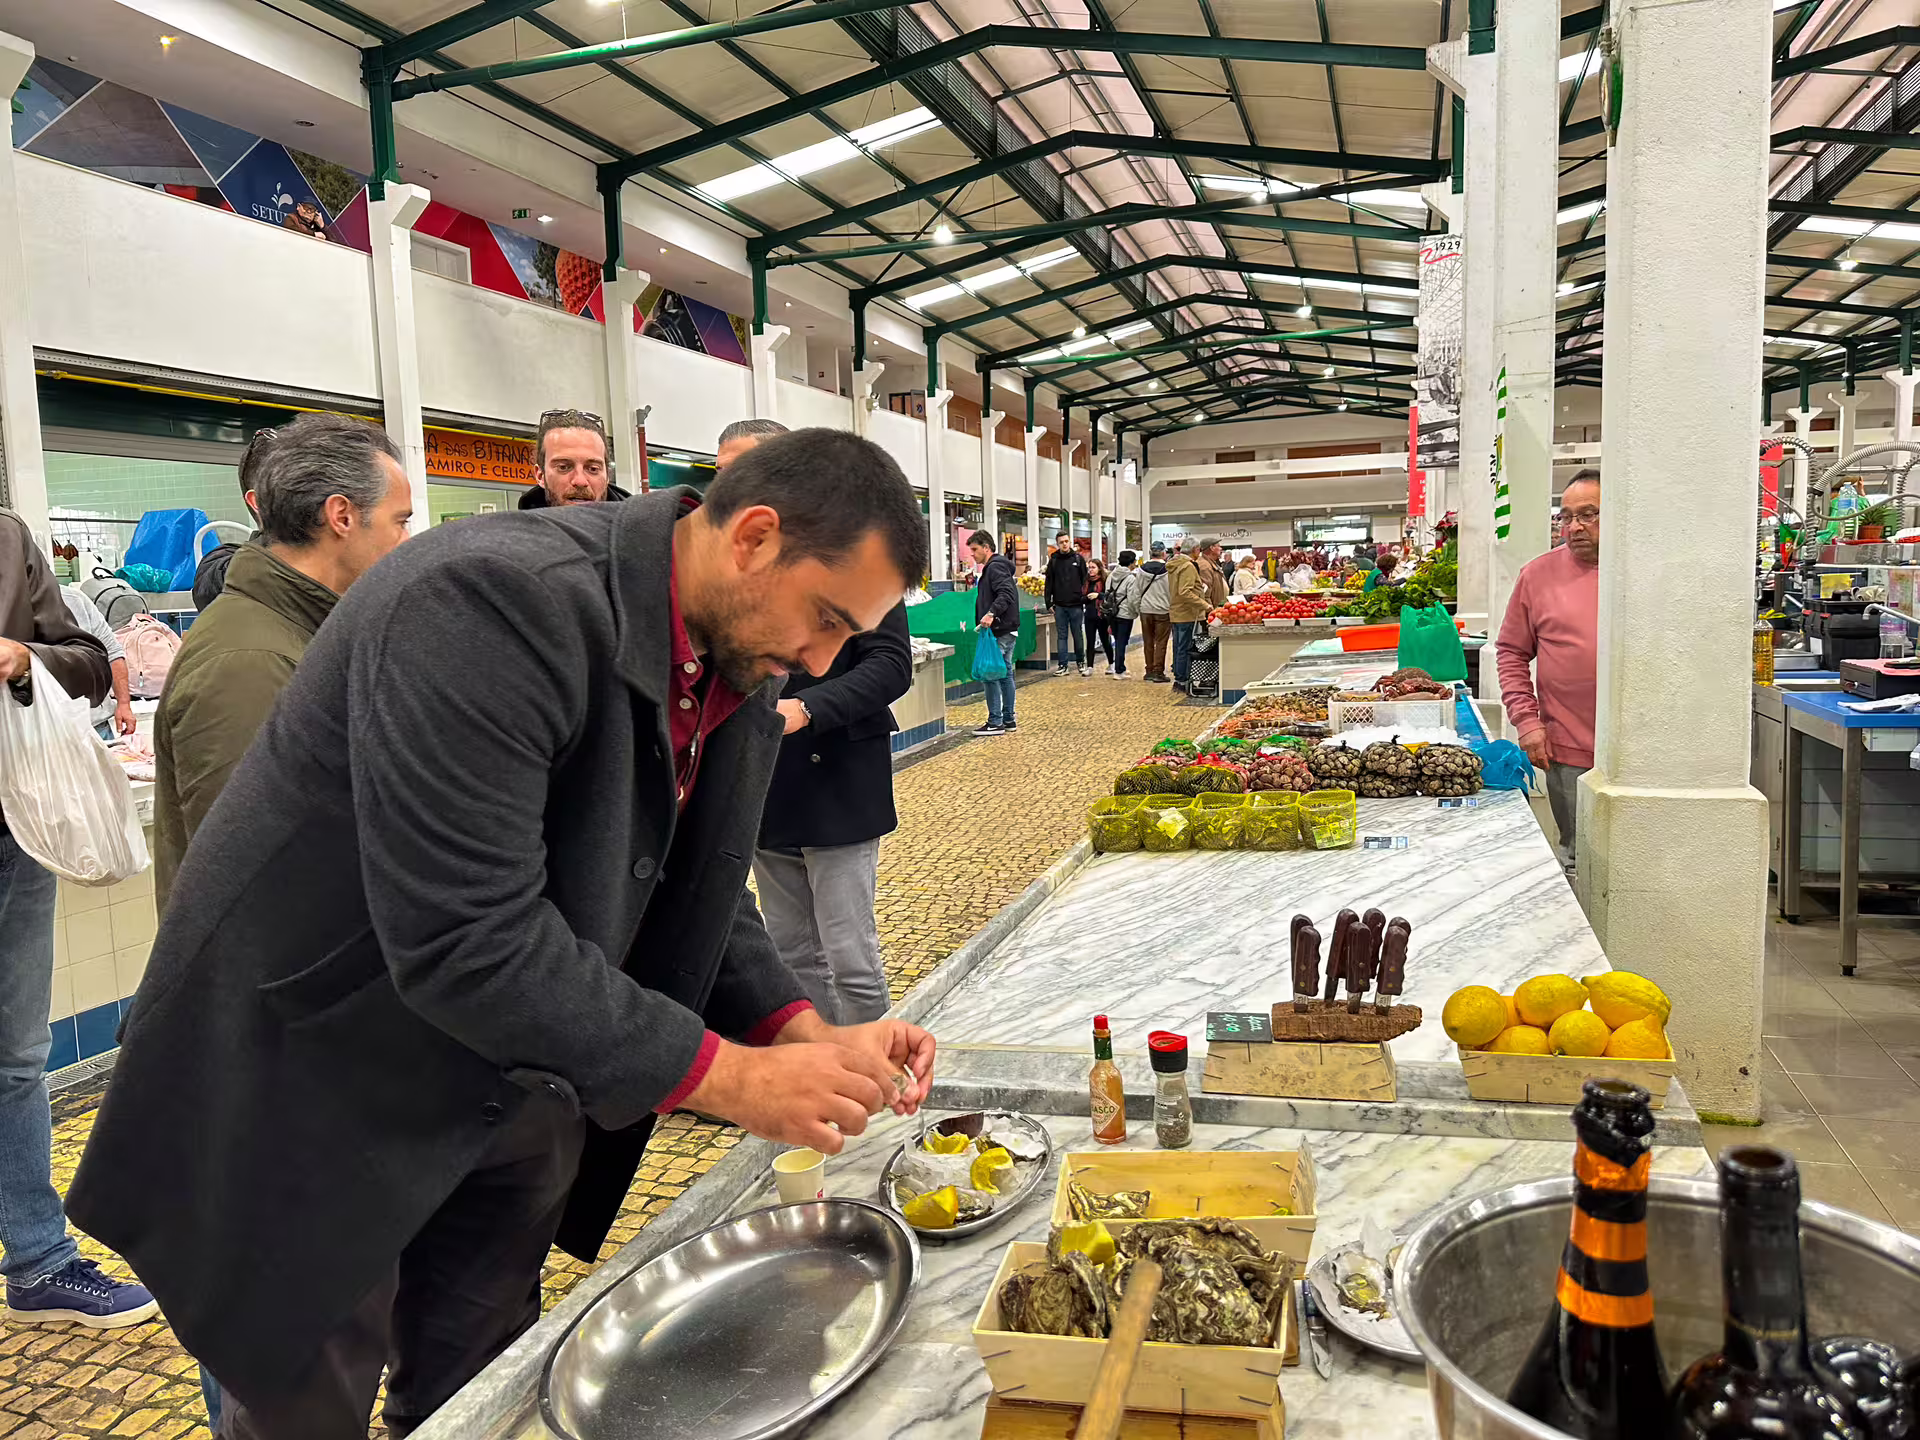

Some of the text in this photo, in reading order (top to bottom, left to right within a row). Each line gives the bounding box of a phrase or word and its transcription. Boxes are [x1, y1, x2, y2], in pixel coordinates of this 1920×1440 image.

[251, 202, 288, 224] SETU
[1435, 240, 1461, 251] 1929
[480, 463, 488, 475] E
